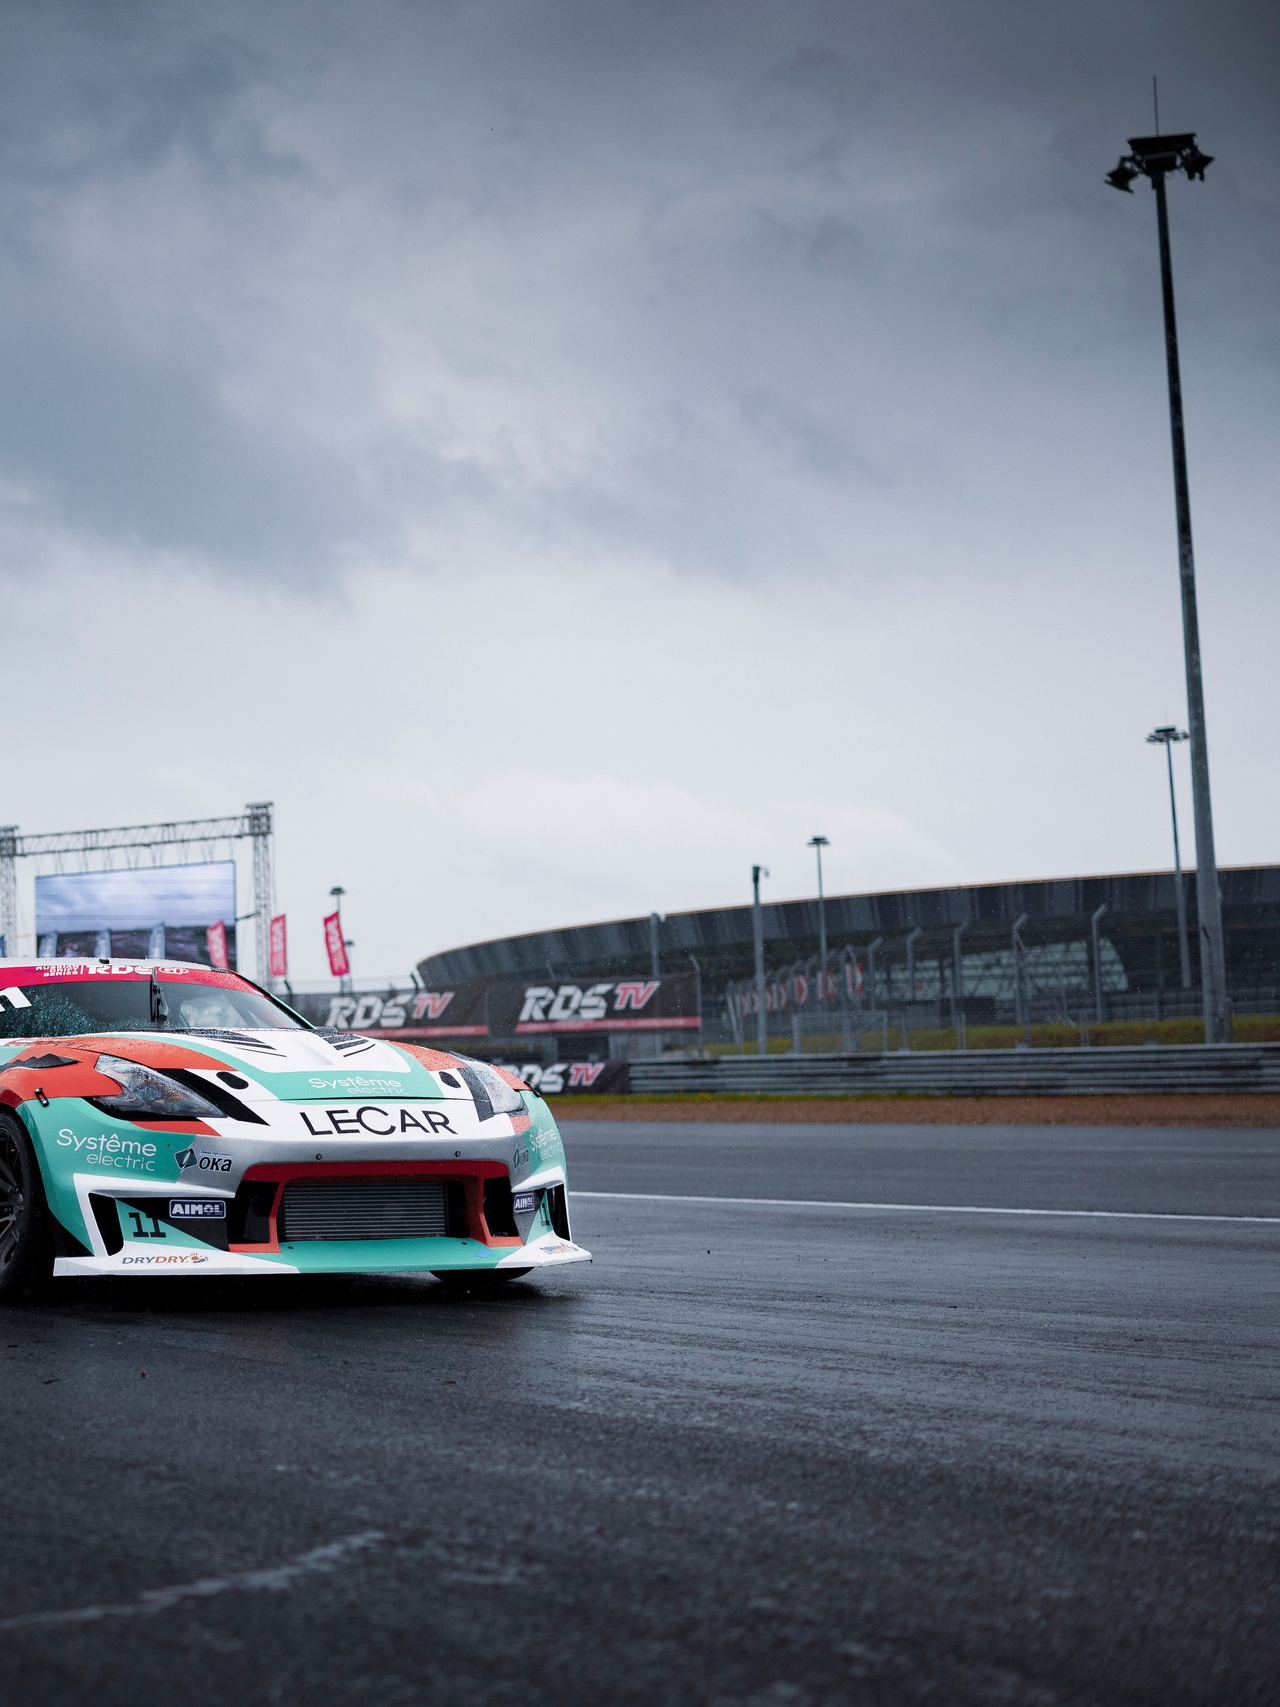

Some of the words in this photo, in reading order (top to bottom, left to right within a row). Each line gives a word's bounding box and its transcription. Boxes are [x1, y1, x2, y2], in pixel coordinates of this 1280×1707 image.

[324, 993, 415, 1030] RDS
[412, 991, 455, 1019] TV
[519, 984, 616, 1021] RDS
[614, 980, 662, 1010] TV
[308, 1075, 402, 1090] Système
[569, 1062, 606, 1087] TV
[347, 1085, 410, 1095] electric
[300, 1106, 459, 1136] LECAR
[56, 1128, 157, 1157] Système
[86, 1151, 156, 1172] electric
[171, 1203, 224, 1216] AIMOL
[128, 1212, 167, 1238] 11
